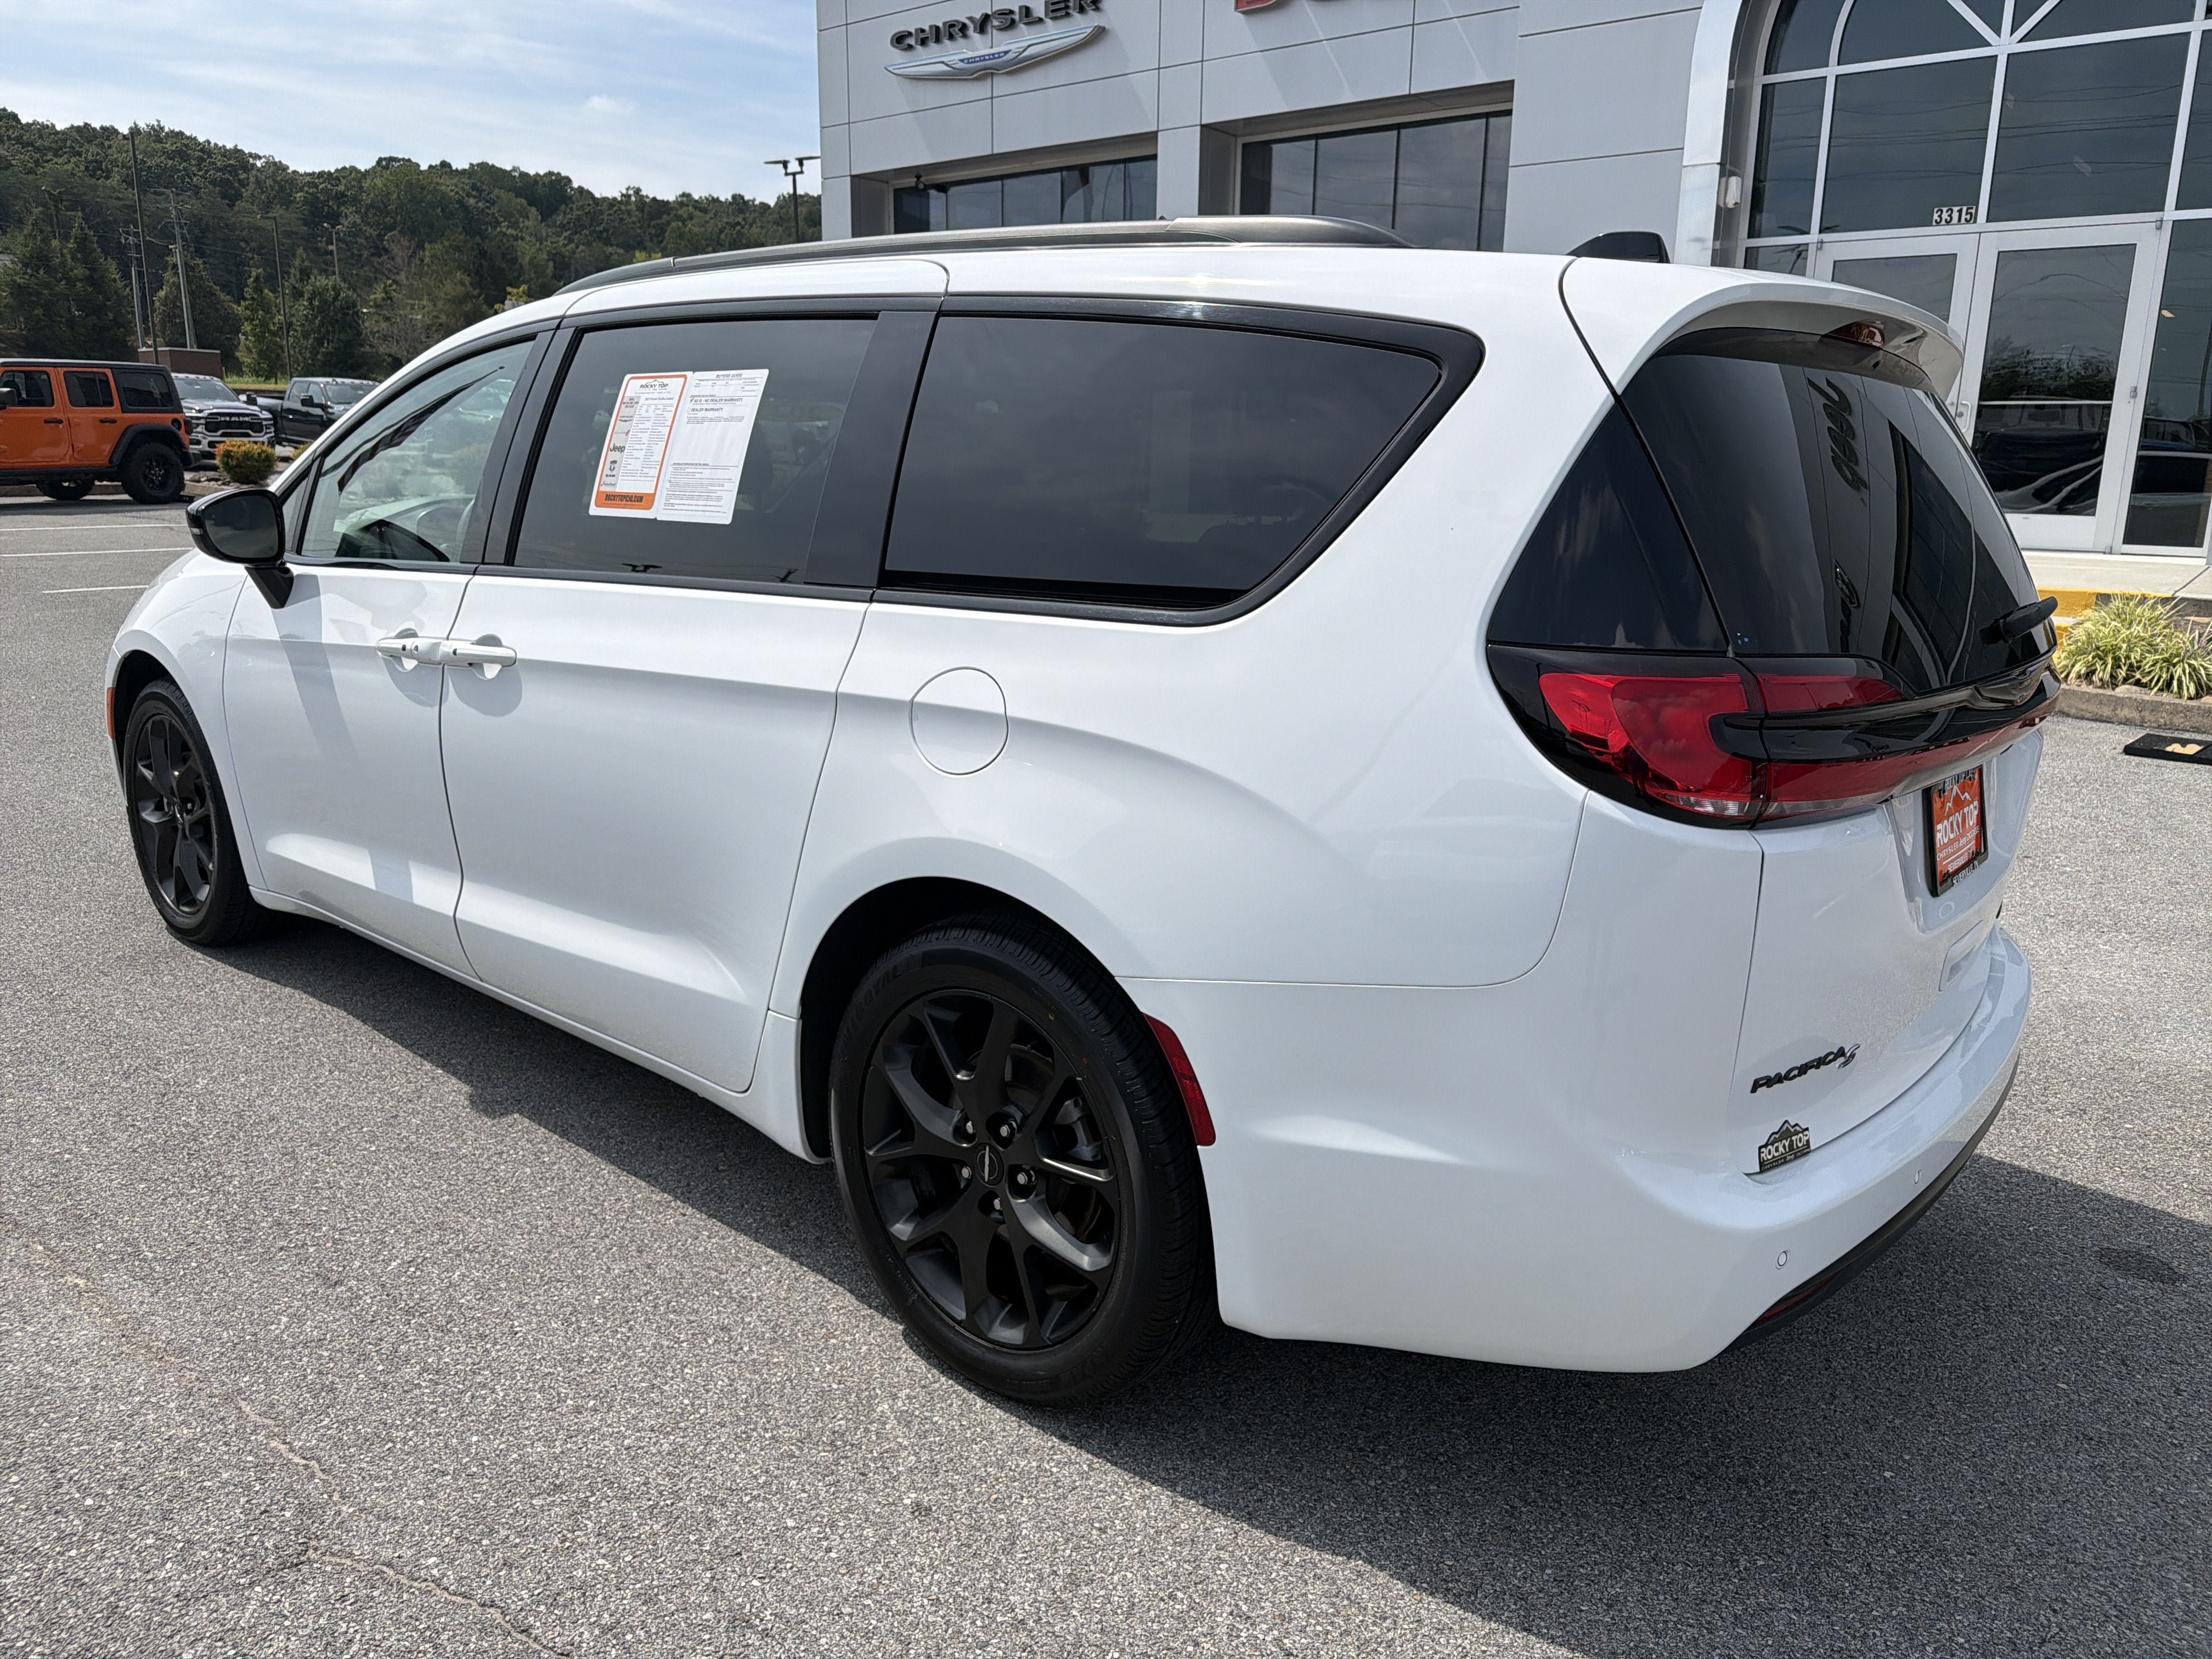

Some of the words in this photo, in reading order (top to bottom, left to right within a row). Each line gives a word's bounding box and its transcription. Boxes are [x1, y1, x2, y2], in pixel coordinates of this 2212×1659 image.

[1934, 207, 1974, 224] 3315
[610, 443, 625, 454] Jeep
[1937, 809, 1963, 848] ROCKY
[1964, 800, 1979, 830] TOP
[1937, 841, 1959, 861] CHRYSLER
[1750, 1046, 1846, 1093] PACIFICA
[1760, 1137, 1791, 1163] ROCKY
[1791, 1131, 1809, 1149] TOP
